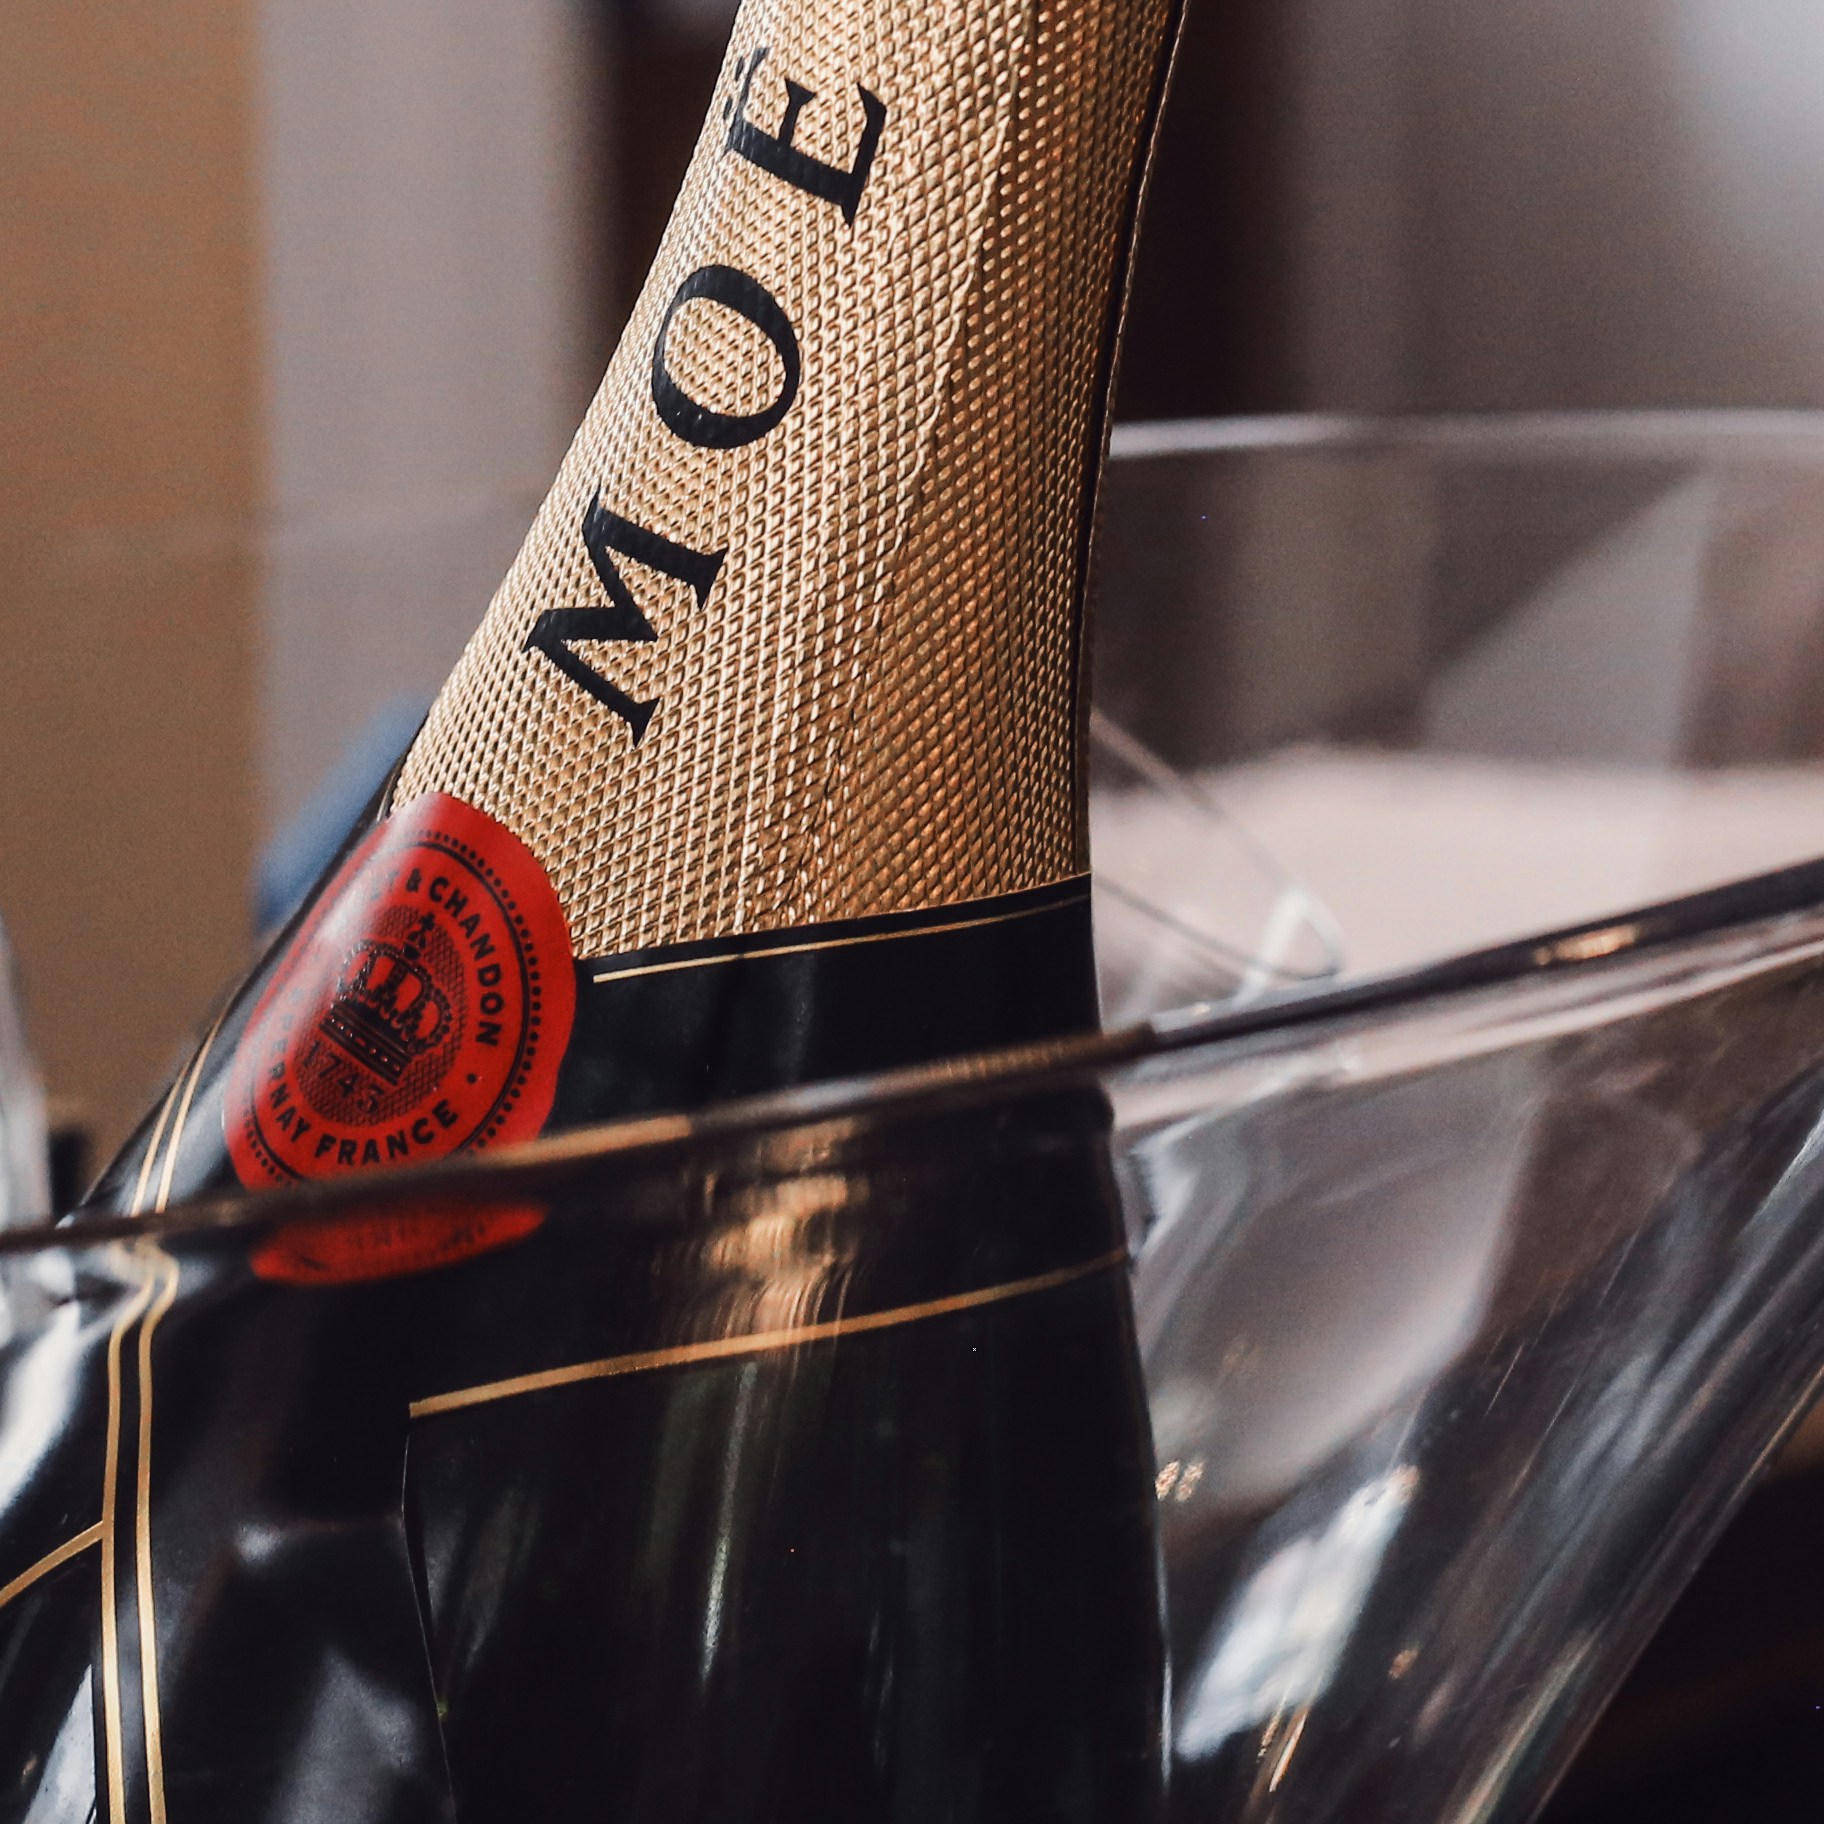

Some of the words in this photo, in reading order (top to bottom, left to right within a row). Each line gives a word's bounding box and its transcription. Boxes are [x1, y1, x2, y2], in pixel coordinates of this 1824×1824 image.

[429, 876, 505, 1046] CHANDON
[303, 1040, 385, 1114] 1743
[314, 1099, 459, 1166] FRANCE
